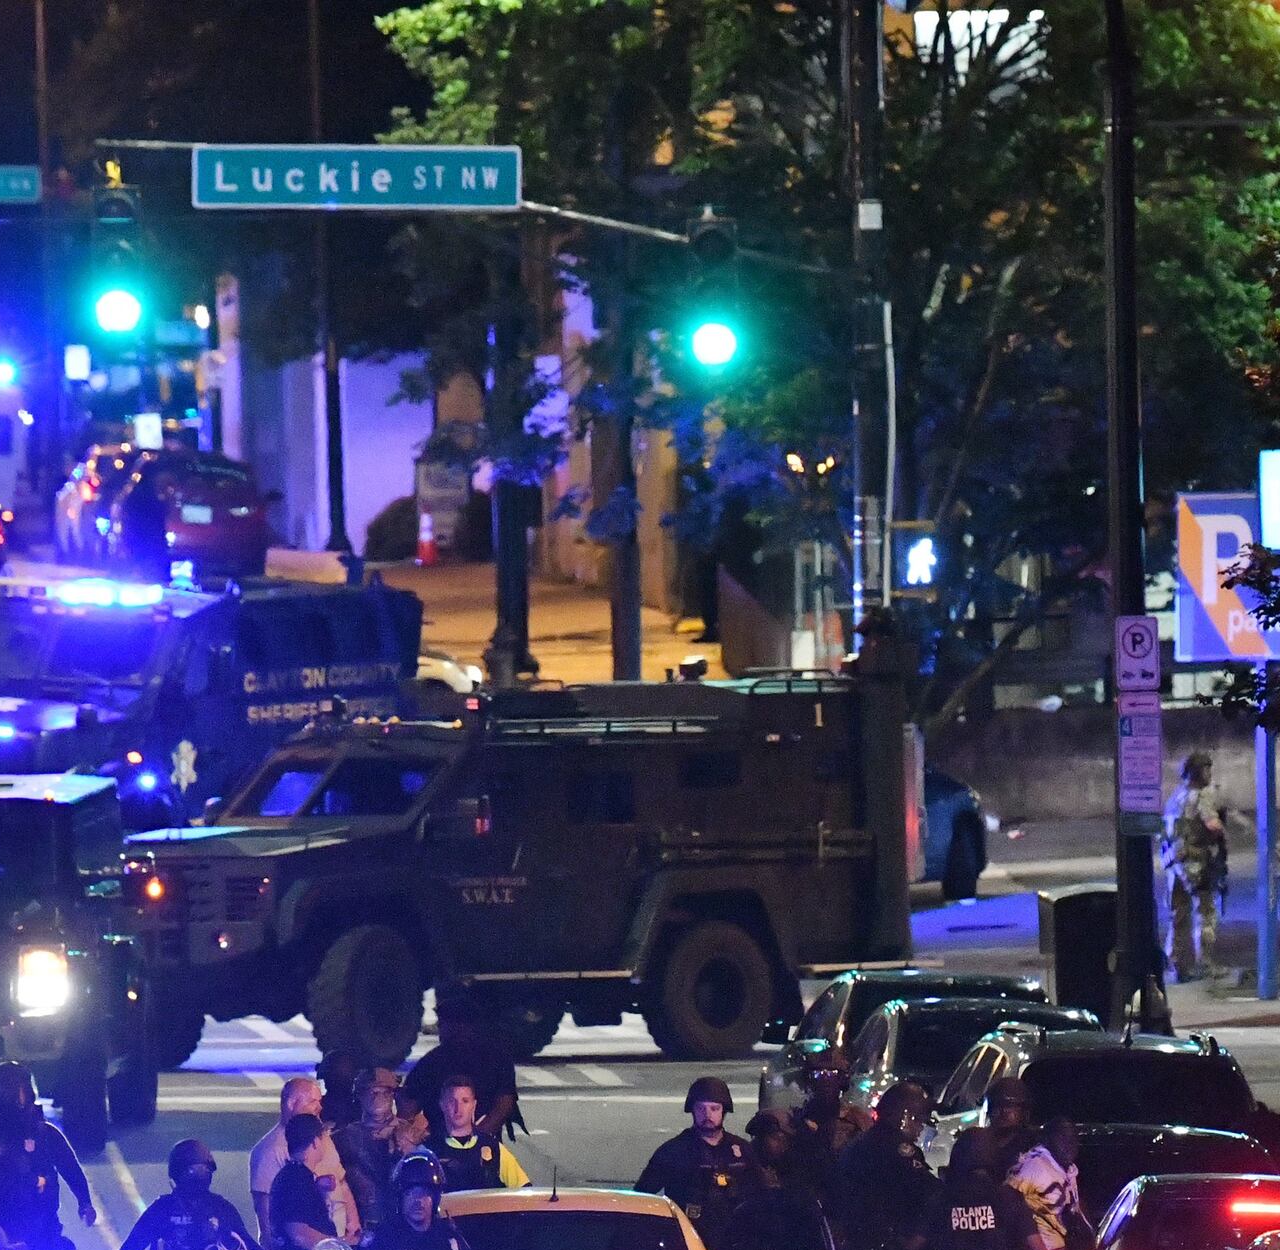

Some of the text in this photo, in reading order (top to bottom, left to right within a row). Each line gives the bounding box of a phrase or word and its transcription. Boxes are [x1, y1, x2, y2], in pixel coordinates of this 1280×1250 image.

[213, 159, 500, 194] Luckie ST NW
[1193, 513, 1254, 606] P
[1131, 632, 1145, 652] P
[951, 1205, 995, 1218] ATLANTA
[951, 1215, 996, 1231] POLICE
